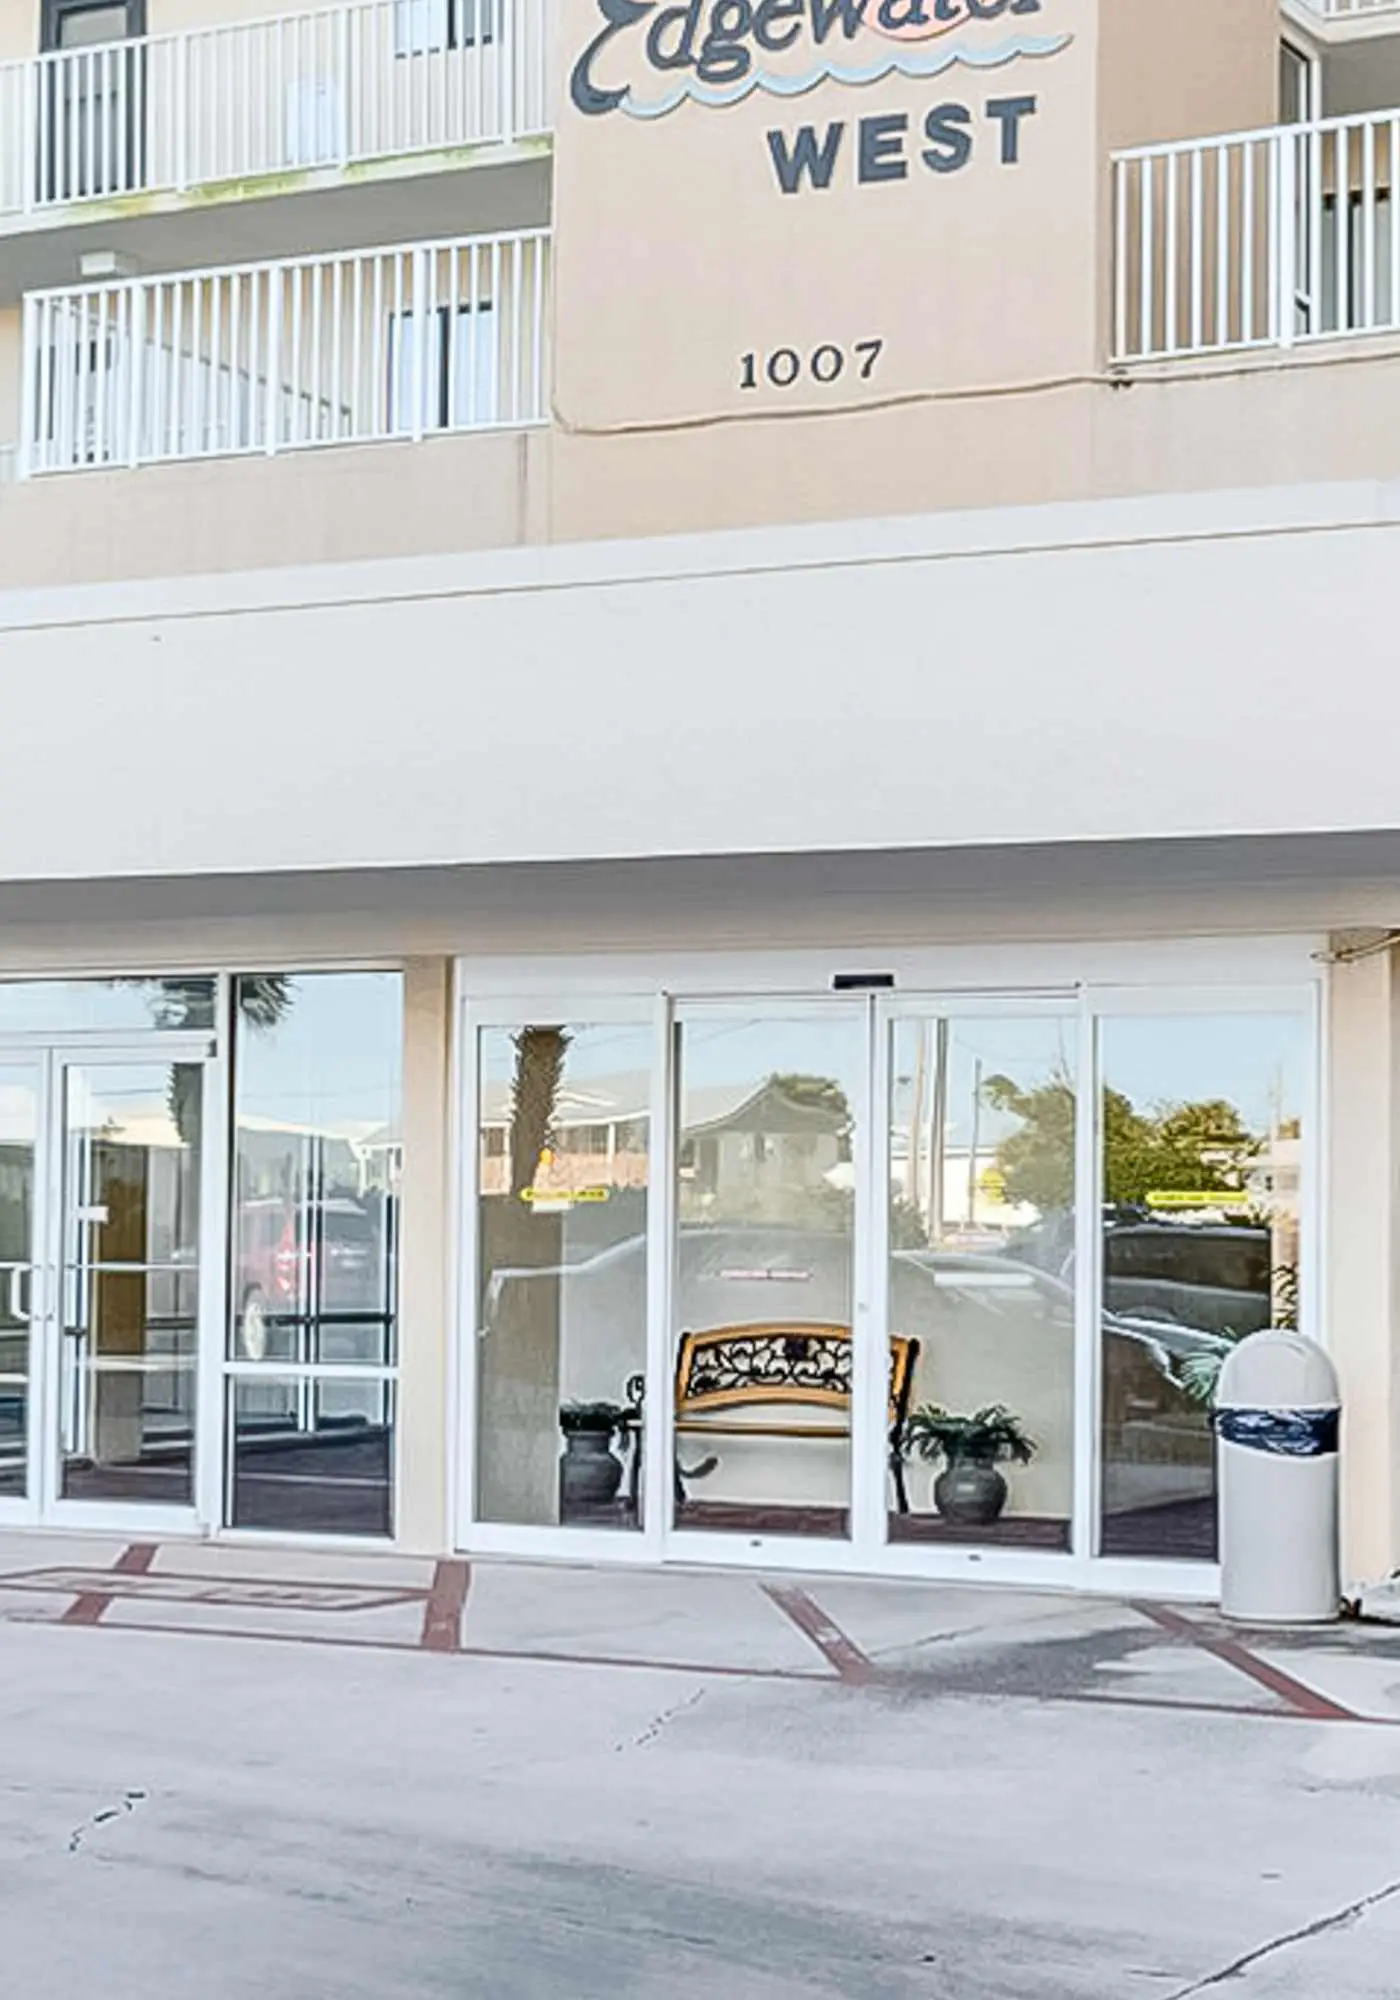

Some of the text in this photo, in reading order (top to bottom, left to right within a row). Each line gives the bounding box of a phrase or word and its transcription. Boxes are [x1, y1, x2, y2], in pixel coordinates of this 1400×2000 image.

[571, 0, 1040, 114] Edgewa
[767, 95, 1037, 194] WEST
[740, 339, 883, 388] 1007
